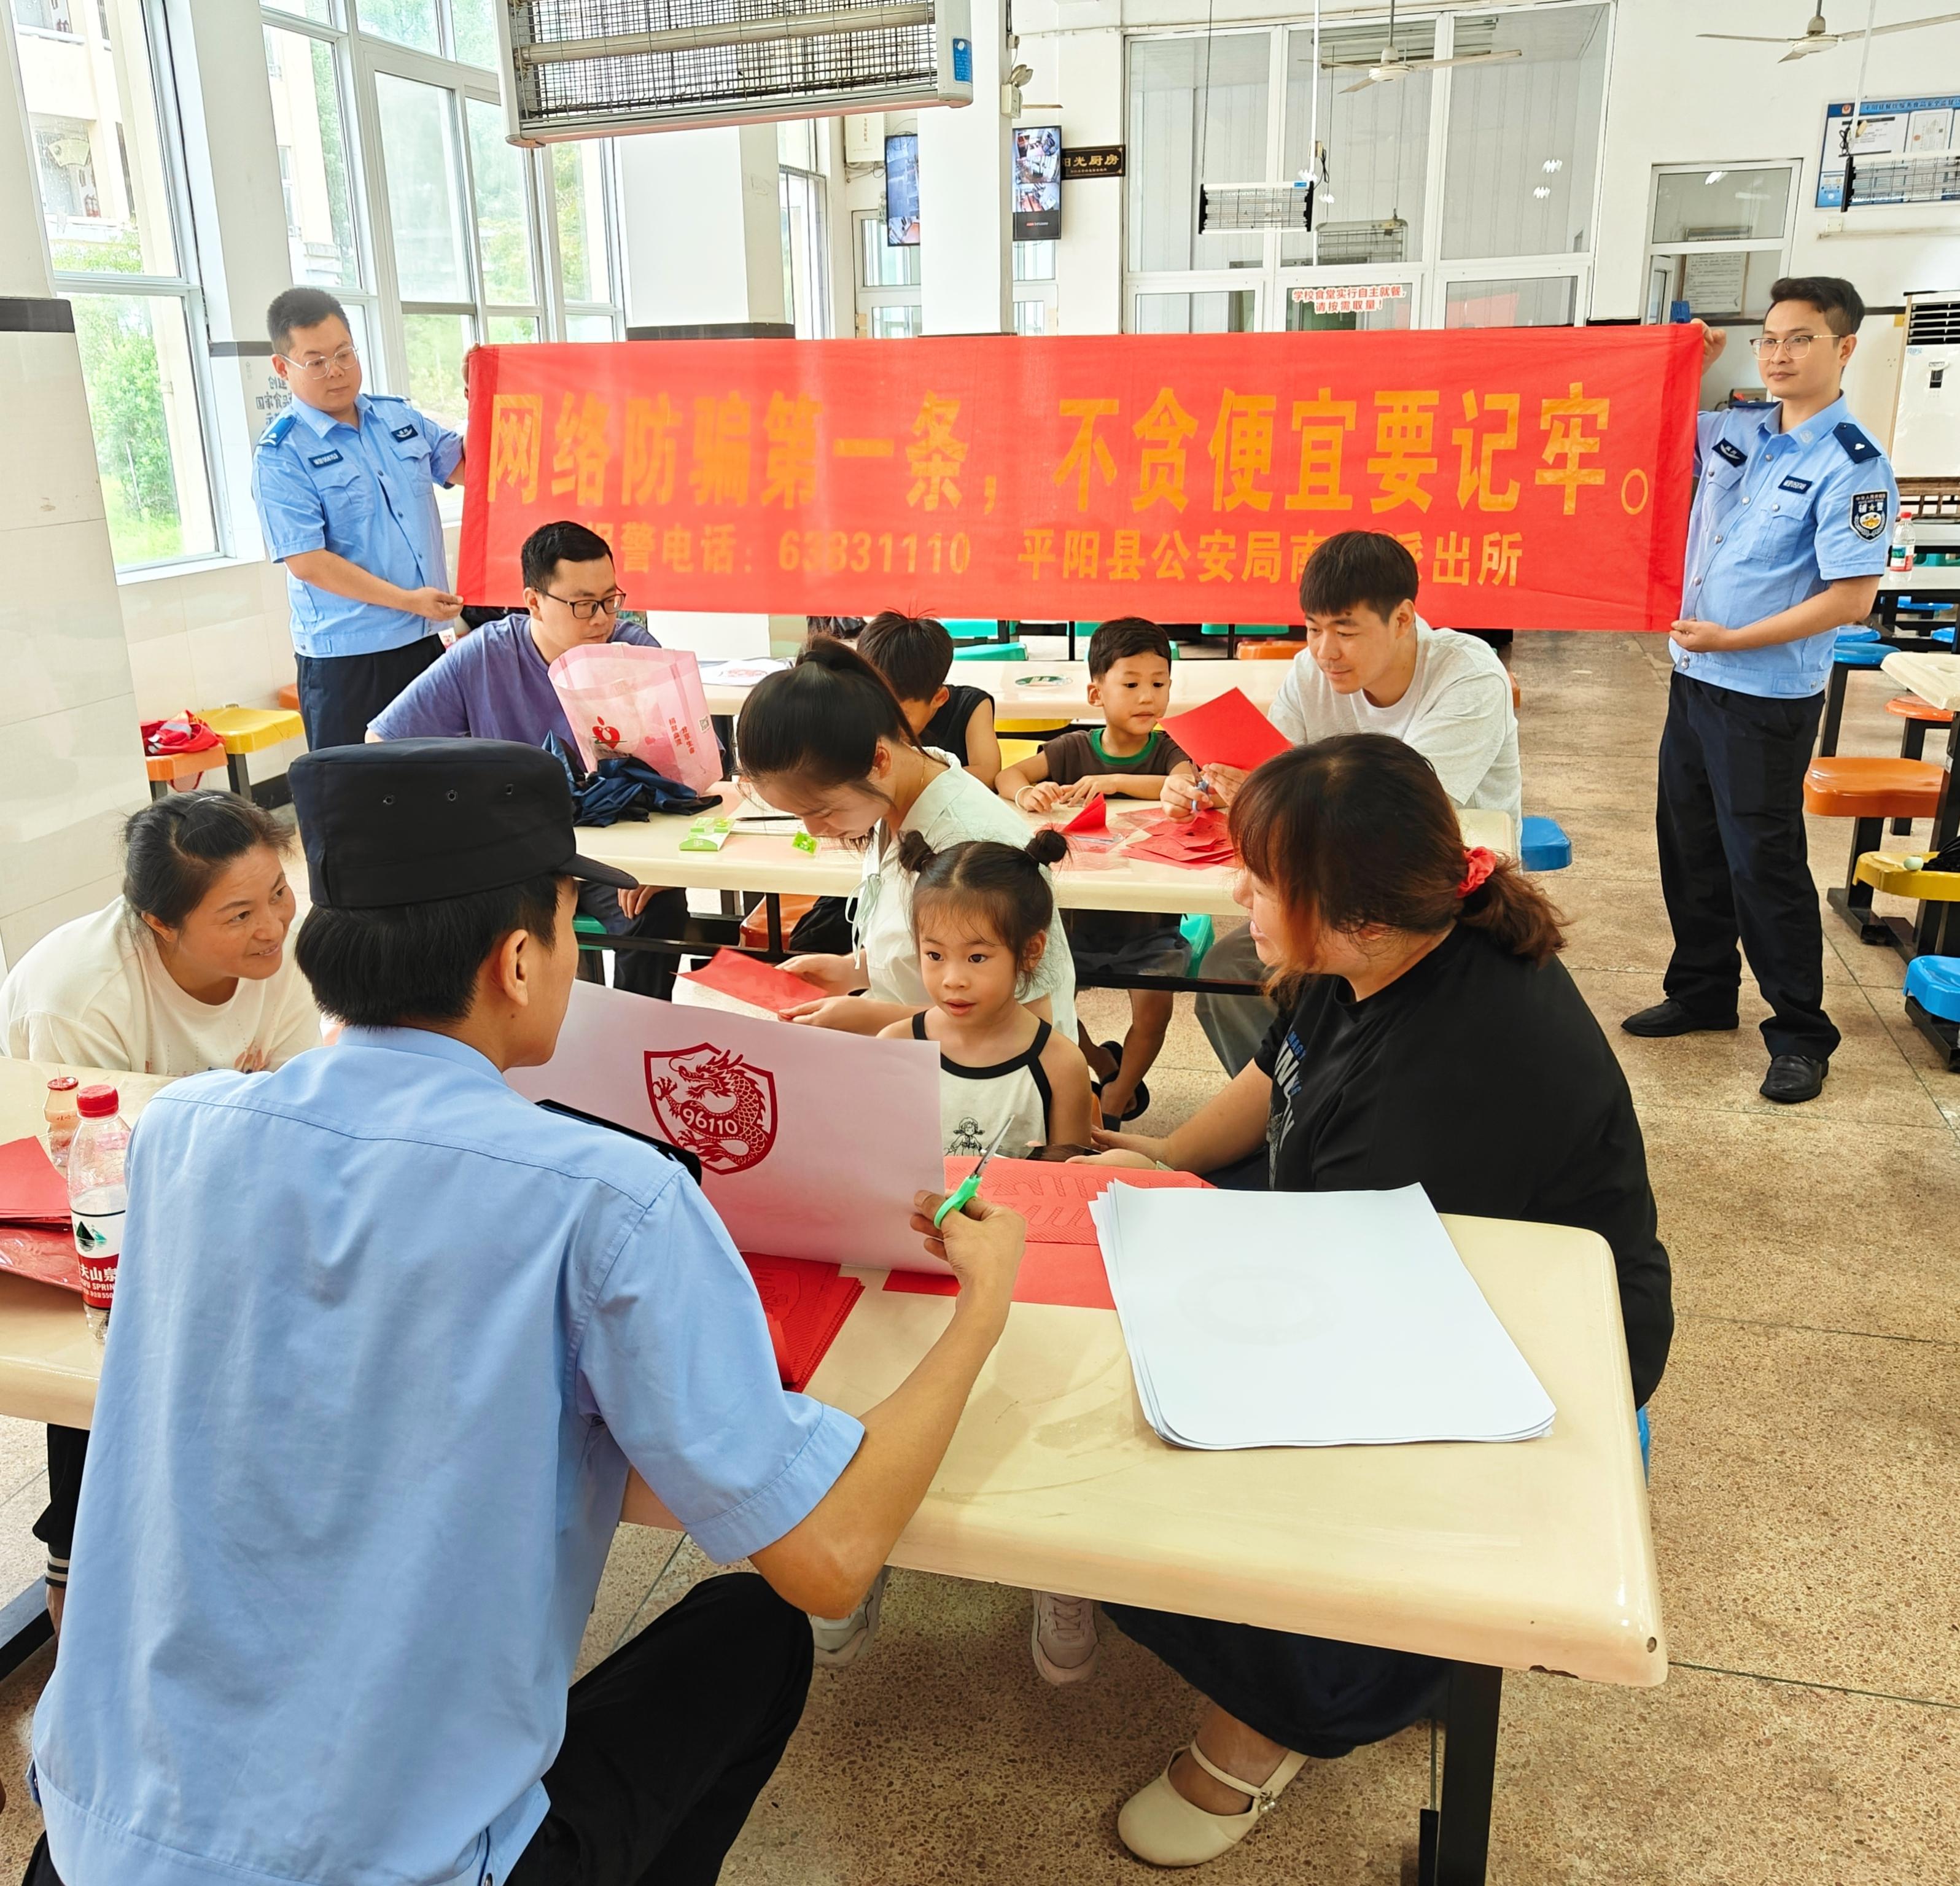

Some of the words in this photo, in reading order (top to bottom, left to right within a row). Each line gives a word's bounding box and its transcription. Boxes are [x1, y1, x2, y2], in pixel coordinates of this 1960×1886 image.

[1017, 527, 1523, 587] 平阳县公安局南出所
[682, 1108, 738, 1135] 96110
